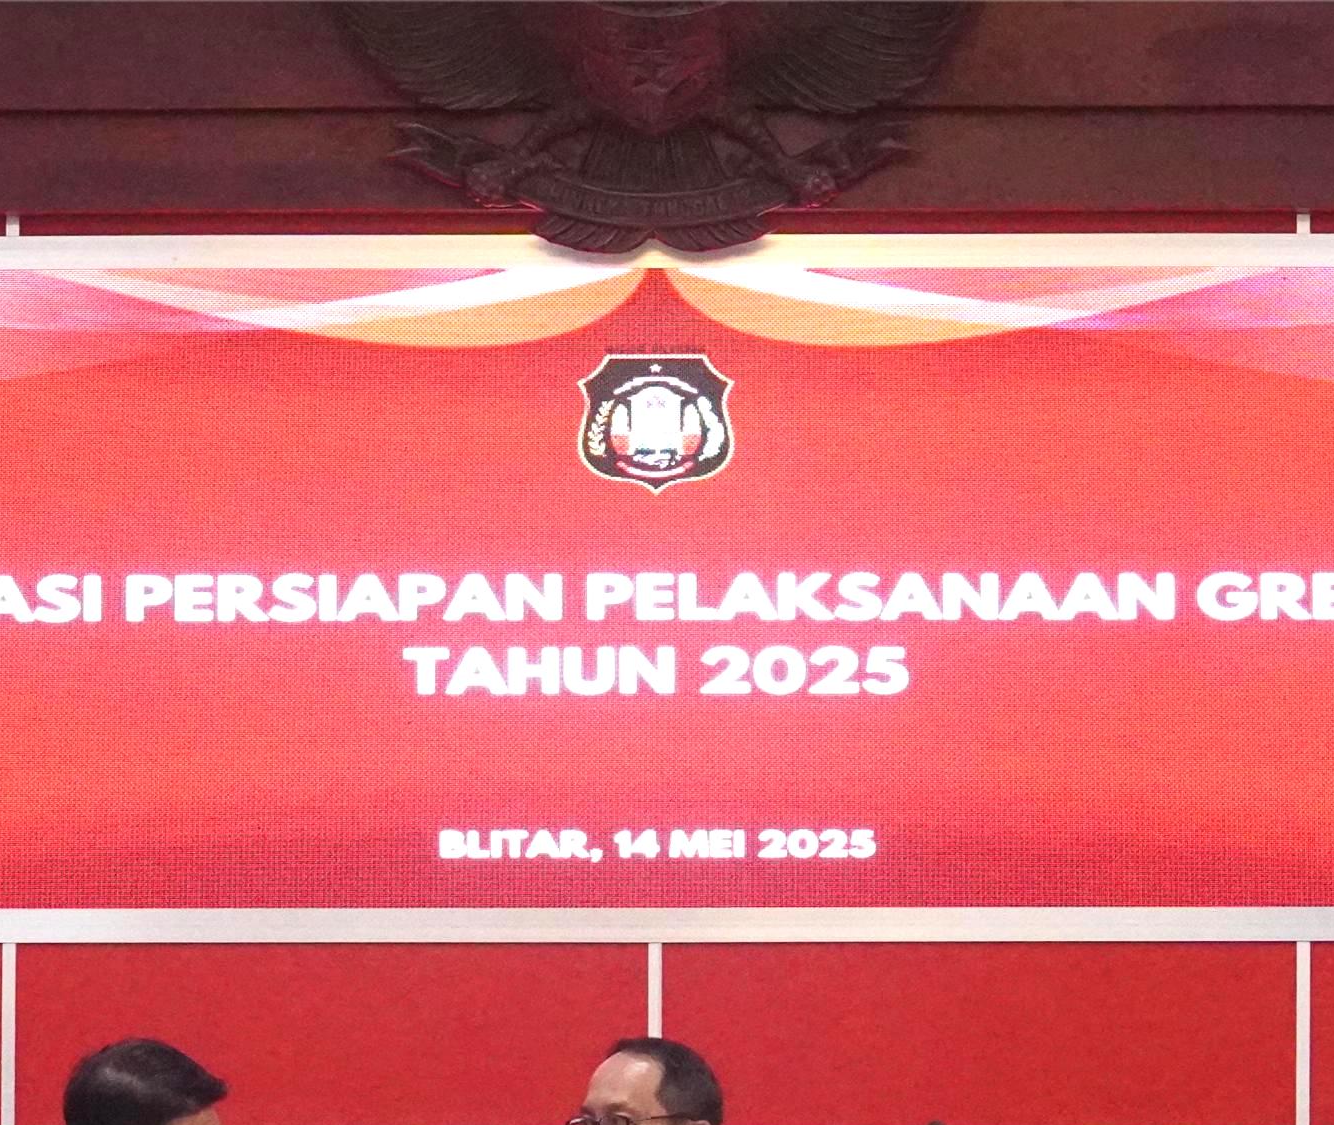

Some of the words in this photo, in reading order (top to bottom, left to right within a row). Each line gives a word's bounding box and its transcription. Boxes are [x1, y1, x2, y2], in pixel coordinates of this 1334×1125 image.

[124, 571, 564, 624] PERSIAPAN
[585, 570, 1177, 623] PELAKSANAAN
[401, 645, 677, 697] TAHUN
[699, 645, 910, 697] 2025
[439, 829, 604, 862] BLITAR,
[613, 829, 661, 859] 14
[667, 829, 746, 859] MEI
[757, 828, 877, 860] 2025
